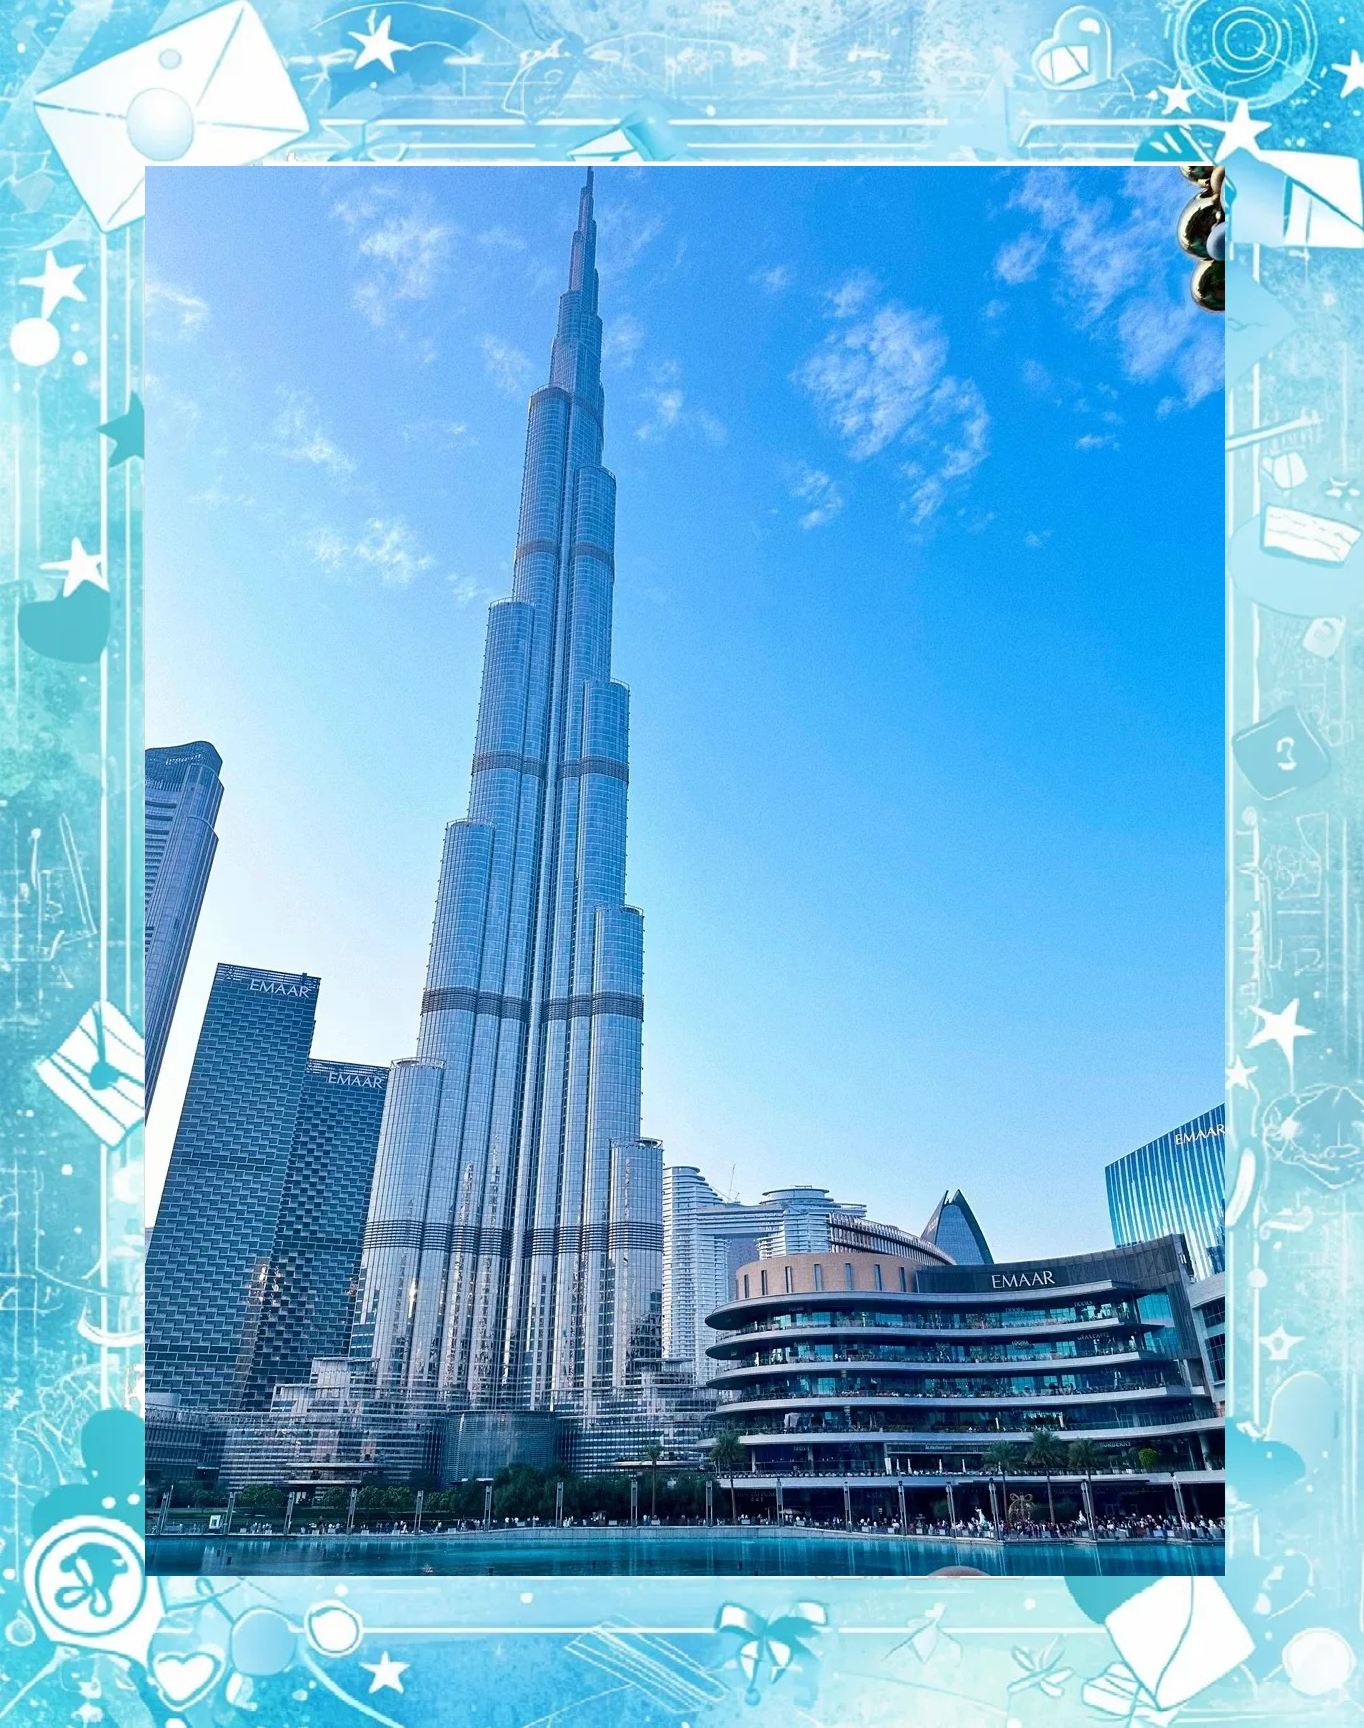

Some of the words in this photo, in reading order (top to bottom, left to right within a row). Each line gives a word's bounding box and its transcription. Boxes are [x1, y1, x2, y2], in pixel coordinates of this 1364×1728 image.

[250, 978, 311, 998] EMAAR
[328, 1072, 383, 1089] EMAAR
[1175, 1123, 1225, 1146] EMAAR
[991, 1270, 1055, 1289] EMAAR
